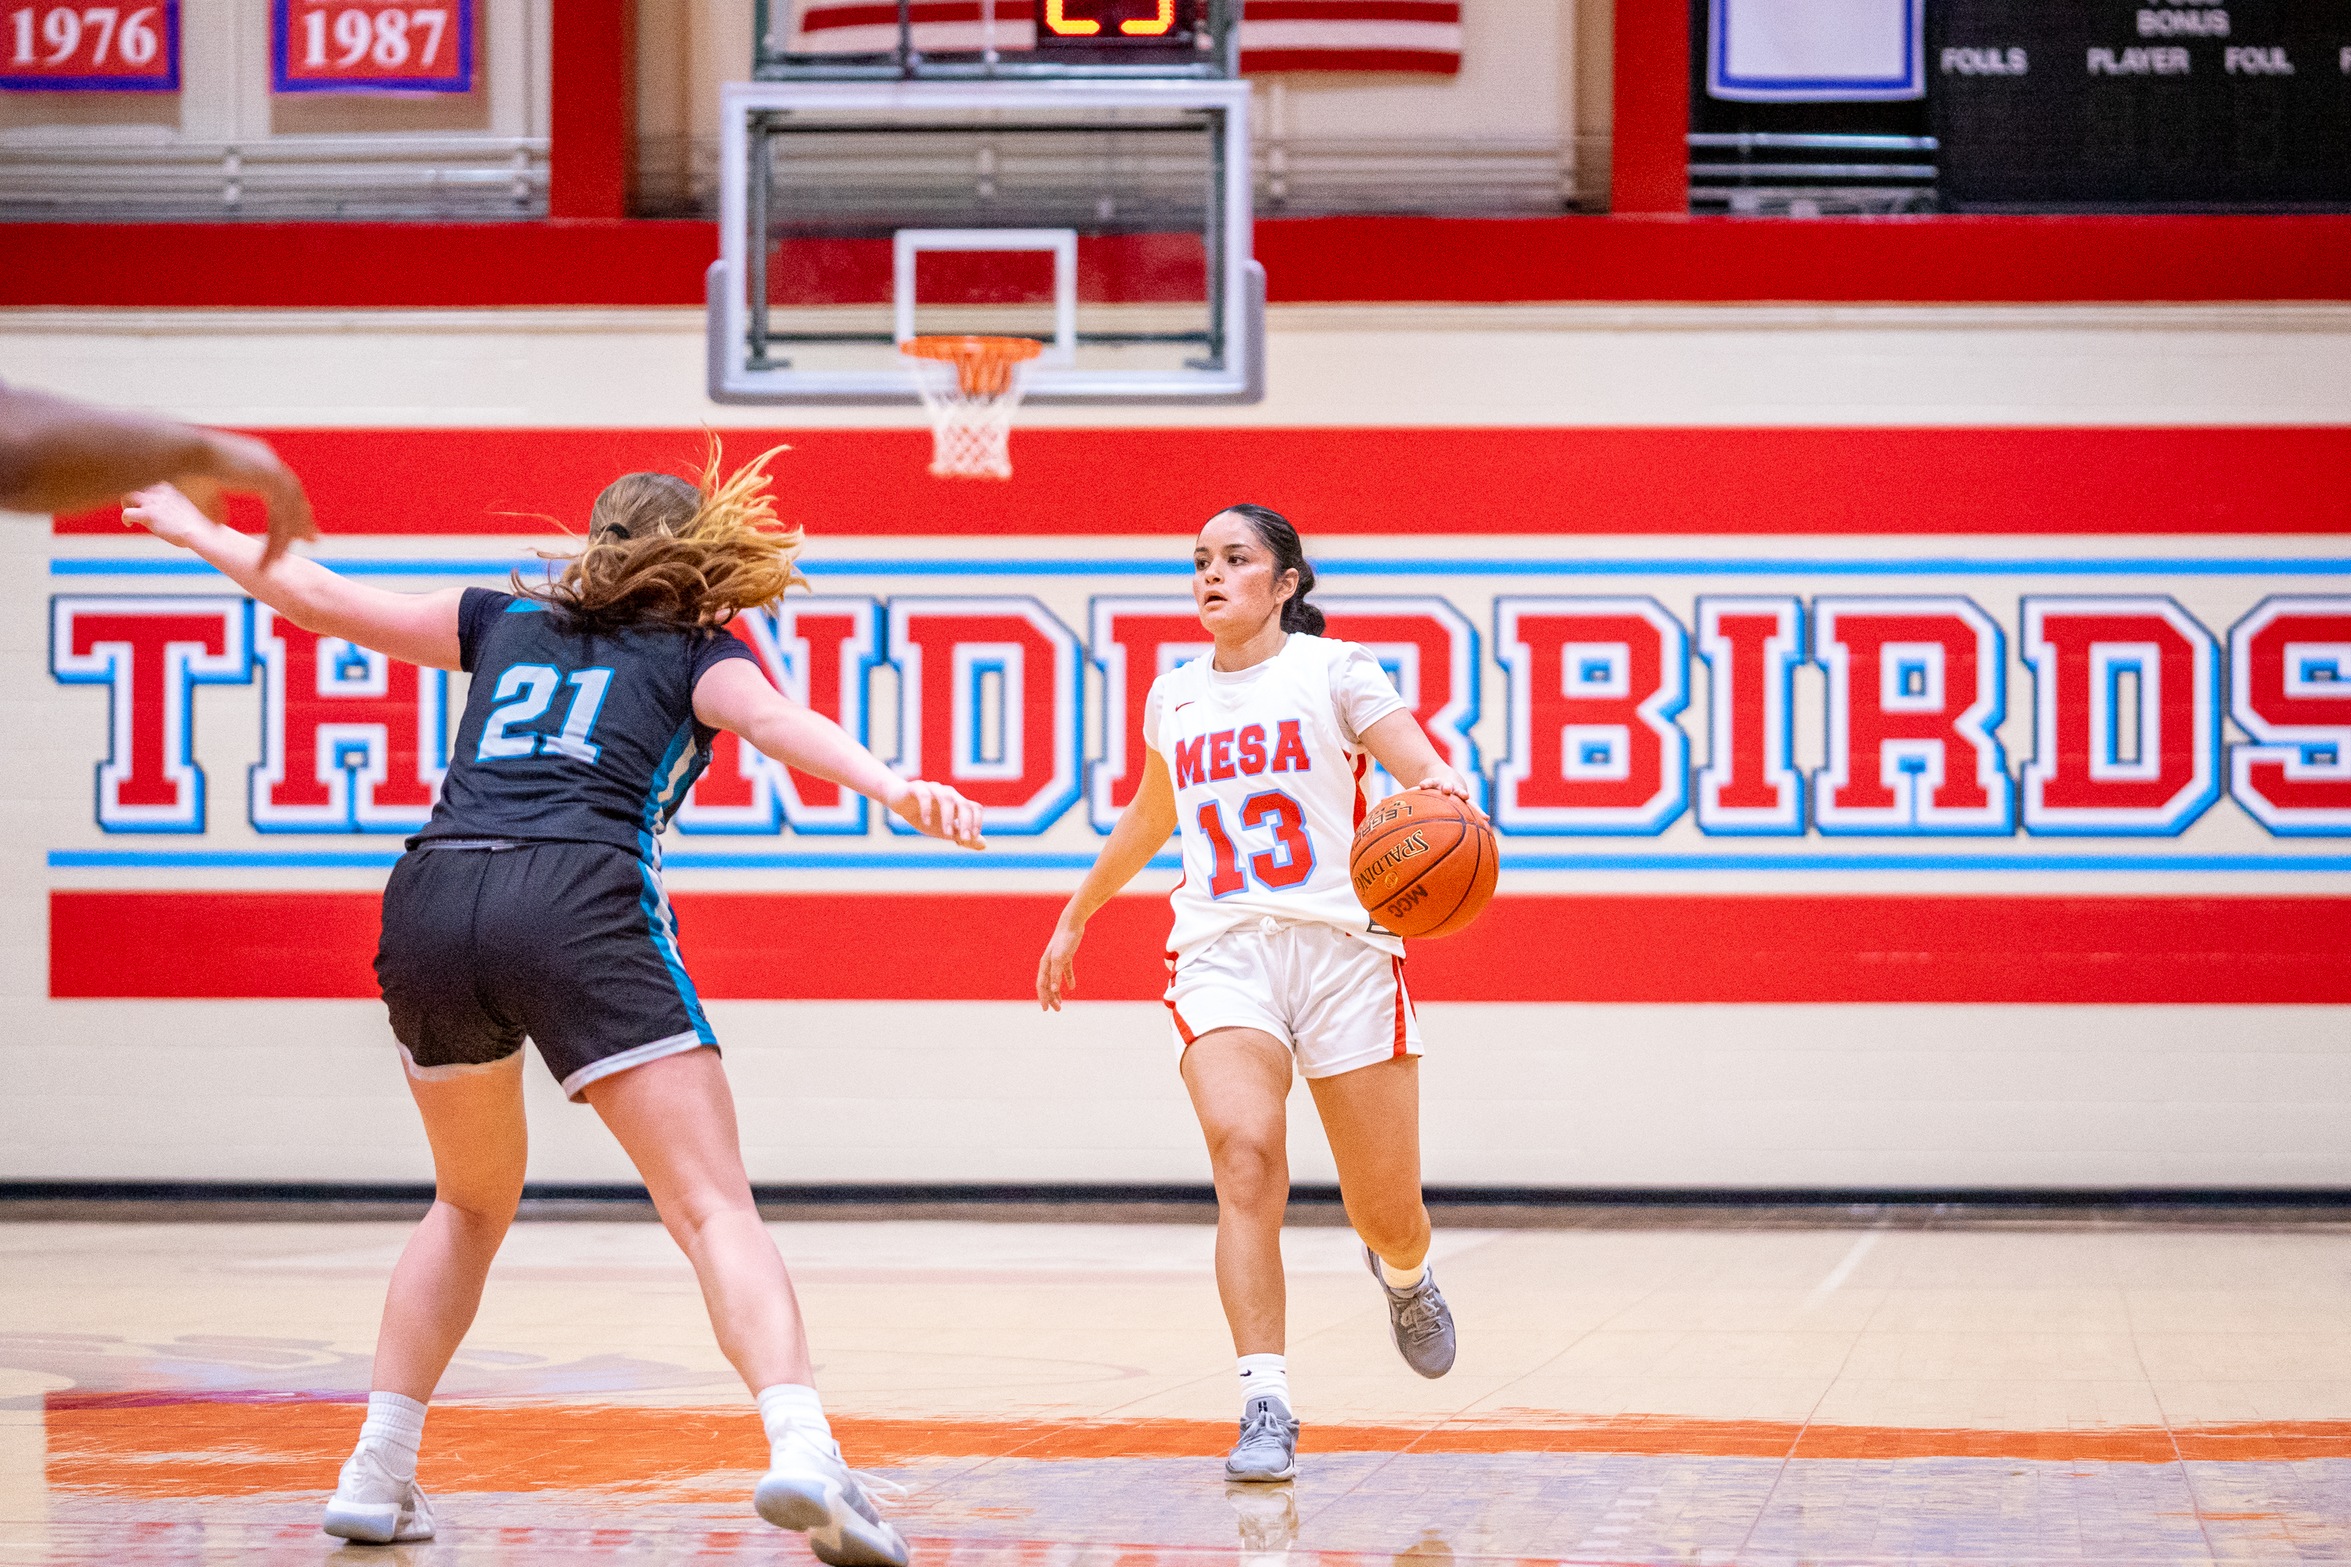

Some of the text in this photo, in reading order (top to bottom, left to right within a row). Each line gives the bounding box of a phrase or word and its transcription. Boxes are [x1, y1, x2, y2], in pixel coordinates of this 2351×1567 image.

[10, 6, 159, 65] 1976
[302, 8, 448, 67] 1987
[2136, 9, 2231, 37] BONUS
[1940, 47, 2028, 75] FOULS
[2086, 46, 2191, 75] PLAYER
[2223, 46, 2296, 75] FOUL
[477, 663, 615, 764] 21
[1175, 718, 1311, 791] MESA
[1196, 788, 1318, 900] 13
[1353, 829, 1431, 897] SPALDING
[1387, 882, 1429, 919] MCC
